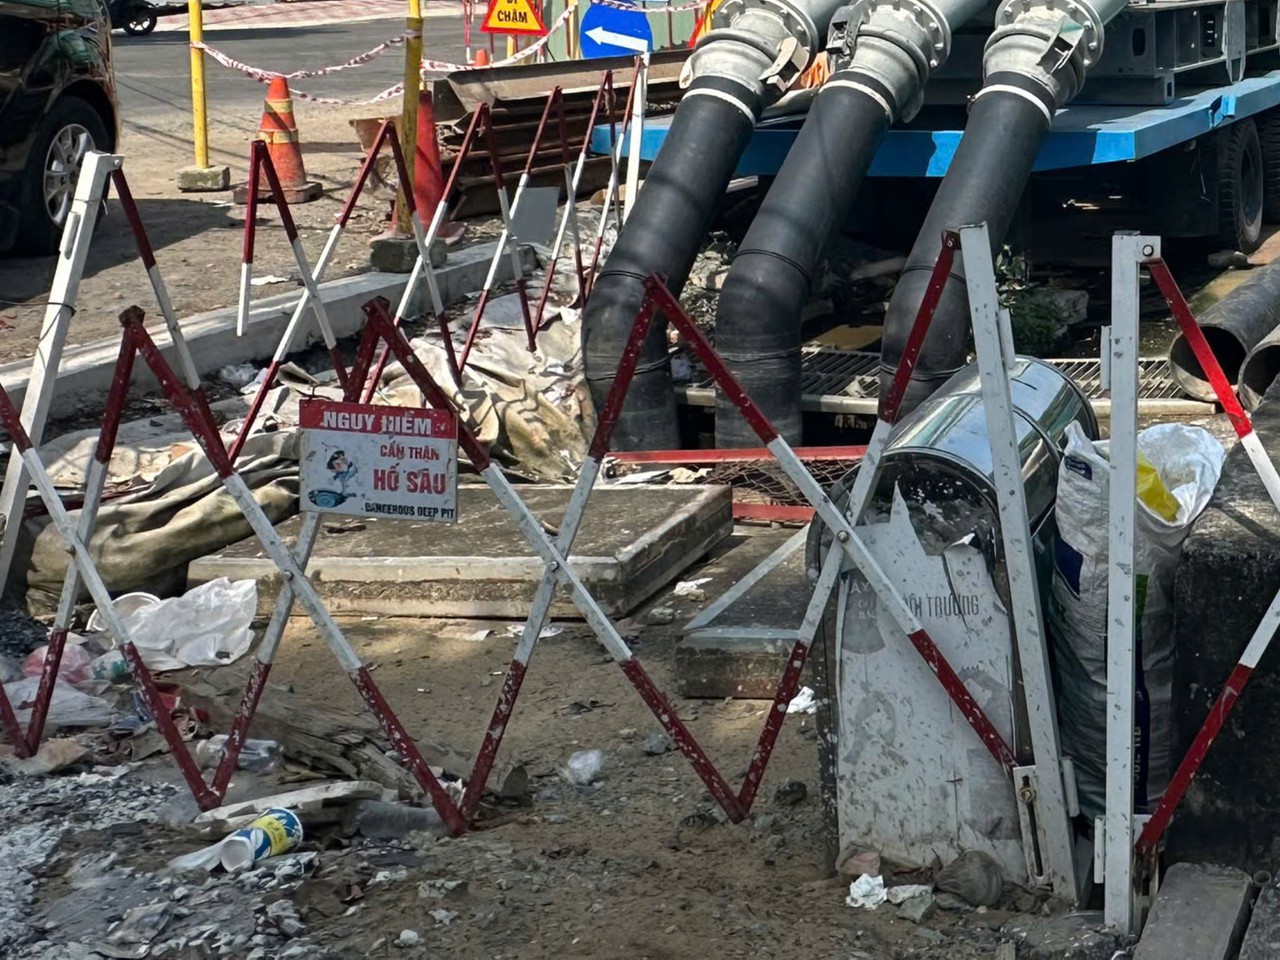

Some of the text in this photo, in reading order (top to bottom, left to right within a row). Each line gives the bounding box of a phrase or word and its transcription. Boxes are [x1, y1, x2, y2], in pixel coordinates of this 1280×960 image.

[323, 411, 375, 431] NGUY
[406, 468, 446, 495] SÂU
[417, 506, 439, 518] DEEP
[441, 508, 455, 519] PIT
